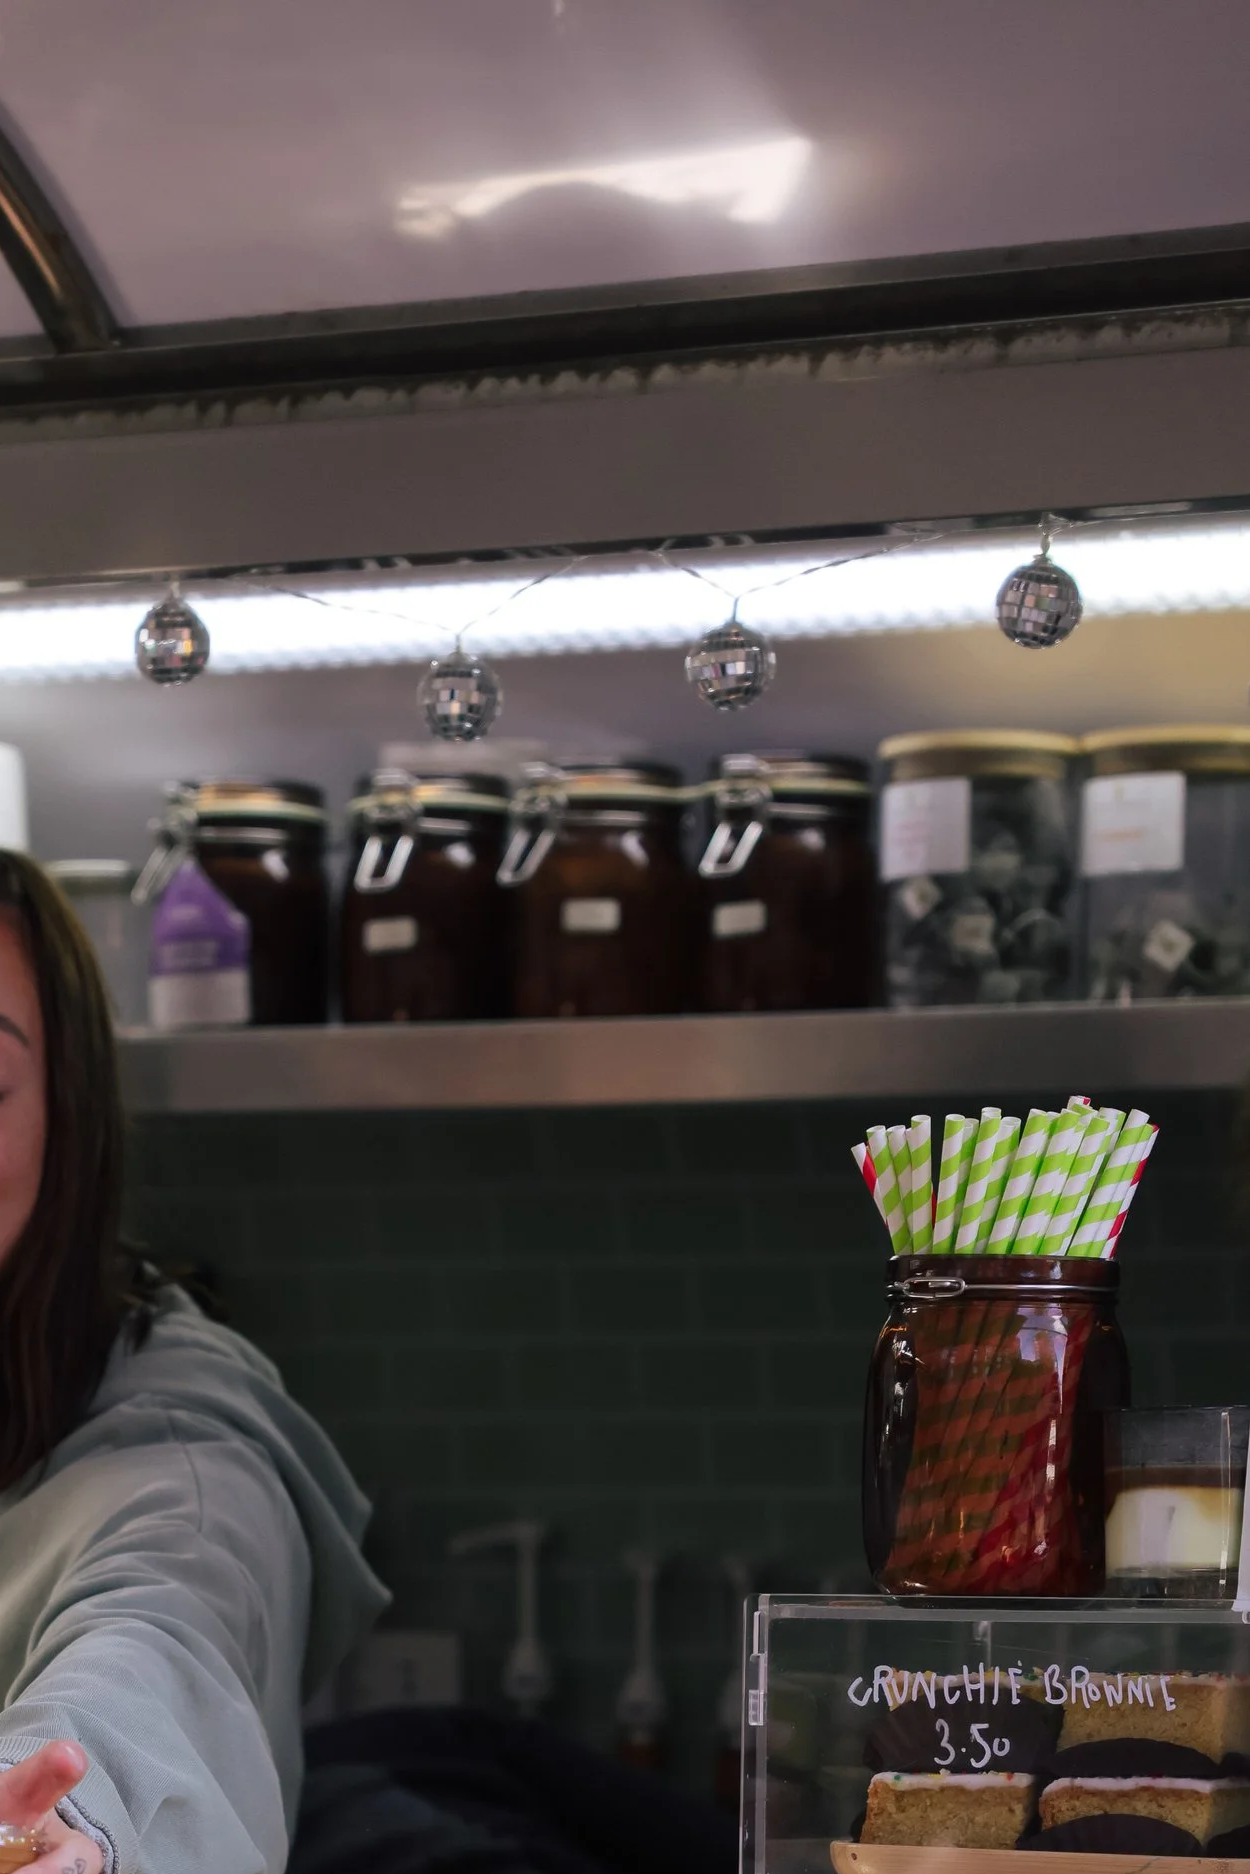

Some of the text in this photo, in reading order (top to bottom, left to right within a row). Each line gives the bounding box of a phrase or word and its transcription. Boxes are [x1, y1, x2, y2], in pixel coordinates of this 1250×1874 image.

[847, 1661, 1176, 1711] CRUNCHIE BROWNIE
[933, 1718, 1010, 1769] 3.50
